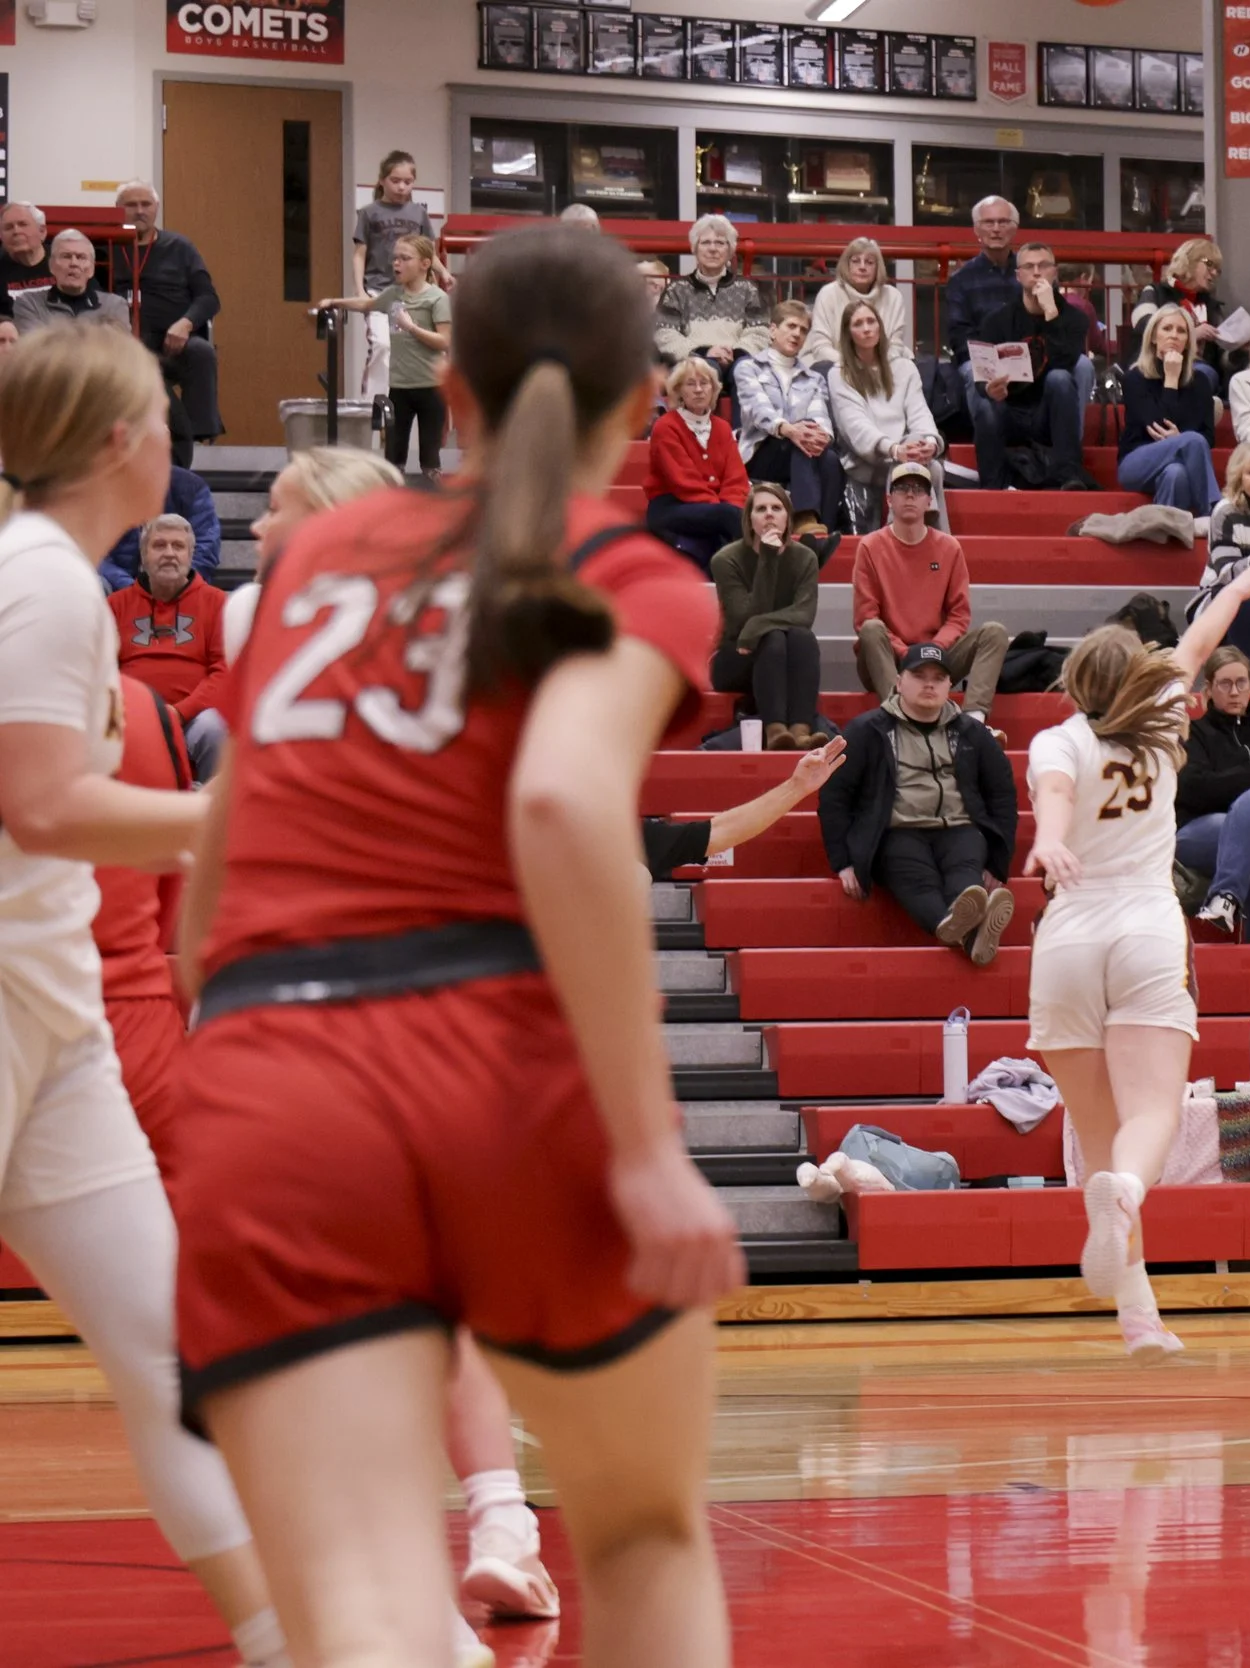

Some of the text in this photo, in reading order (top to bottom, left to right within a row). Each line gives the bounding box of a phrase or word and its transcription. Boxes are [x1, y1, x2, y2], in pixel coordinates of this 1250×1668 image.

[177, 3, 329, 43] COMETS
[184, 36, 327, 54] BOYS BASKETBALL
[992, 61, 1021, 73] HALL
[992, 80, 1022, 93] FAME
[252, 571, 472, 755] 23
